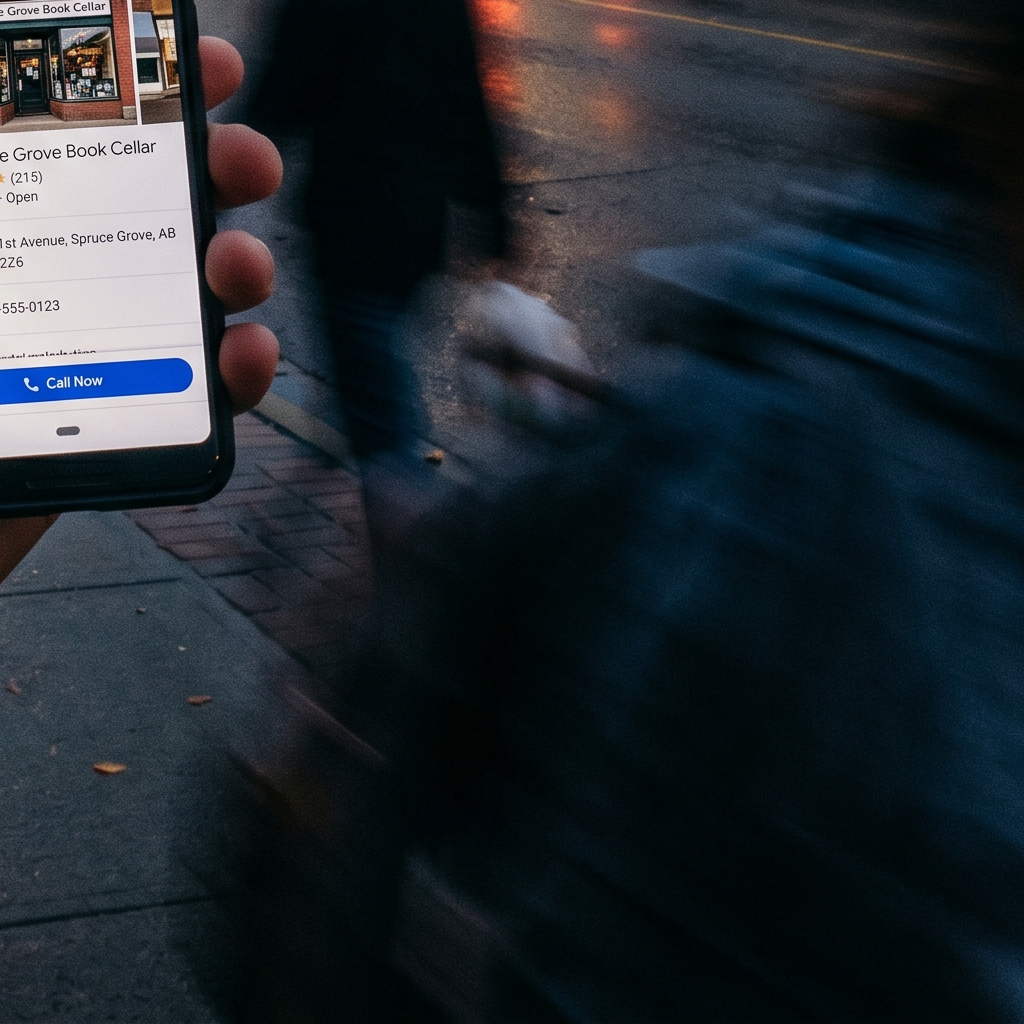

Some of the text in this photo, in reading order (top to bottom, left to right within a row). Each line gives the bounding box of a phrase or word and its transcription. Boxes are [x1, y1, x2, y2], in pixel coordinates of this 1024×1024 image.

[7, 3, 40, 16] Grove
[42, 3, 70, 14] Book
[73, 1, 106, 12] Cellar
[12, 147, 62, 162] Grove
[66, 142, 107, 158] Book
[110, 140, 157, 155] Cellar
[10, 170, 43, 186] (215)
[5, 191, 39, 205] Open
[20, 235, 68, 248] Avenue,
[71, 232, 114, 246] Spruce
[117, 229, 156, 242] Grove,
[158, 227, 177, 239] AB
[0, 256, 24, 269] 2Z6
[46, 375, 103, 389] Call Now
